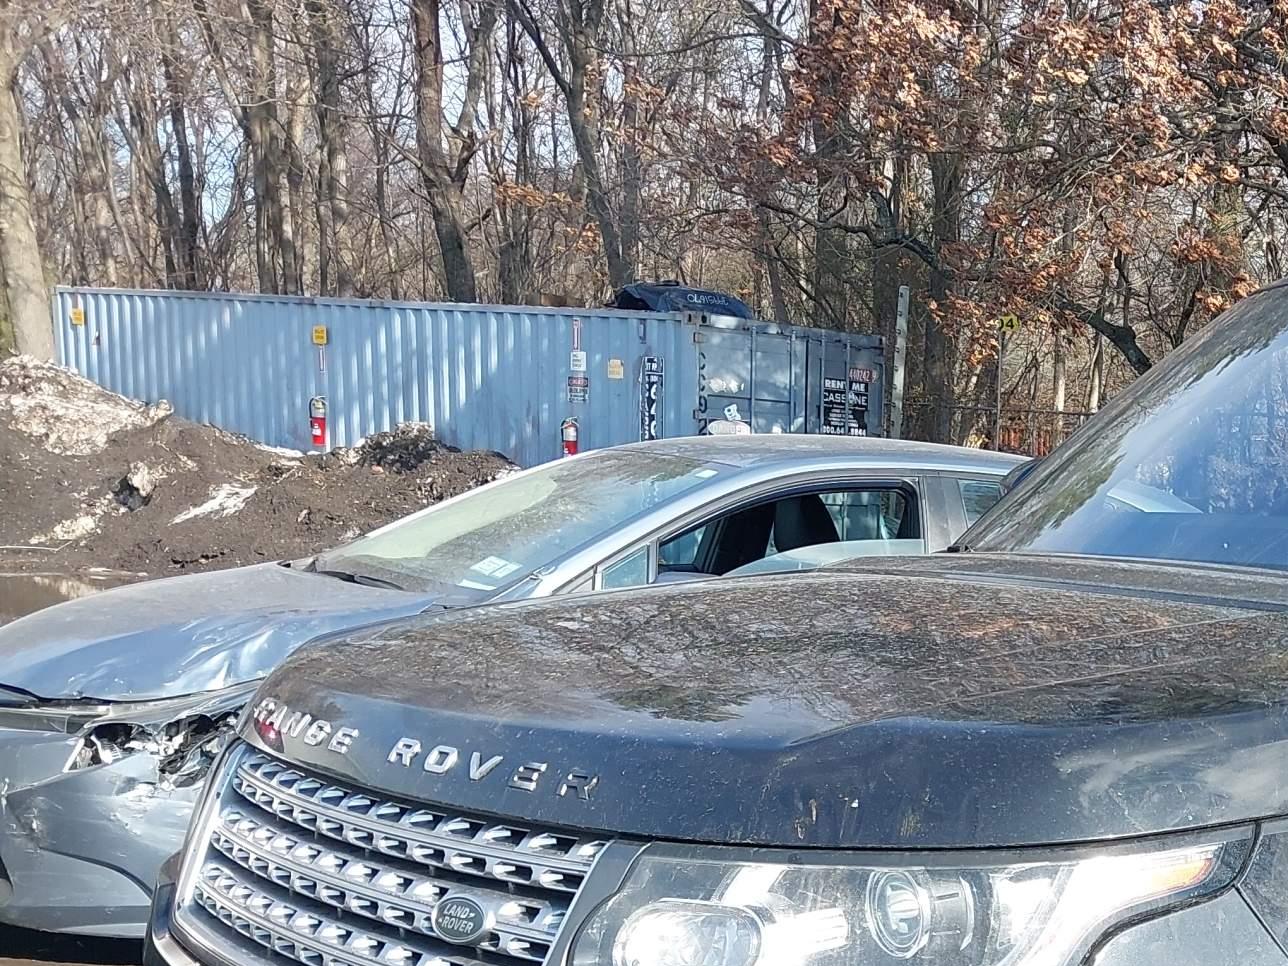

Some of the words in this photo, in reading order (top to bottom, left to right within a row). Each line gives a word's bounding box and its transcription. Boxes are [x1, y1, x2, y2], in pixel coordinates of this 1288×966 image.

[851, 382, 866, 392] ME
[823, 391, 868, 406] CASSNE
[253, 697, 360, 754] RANGE
[388, 737, 600, 800] ROVER
[443, 904, 470, 919] LAND
[441, 916, 474, 934] ROVER
